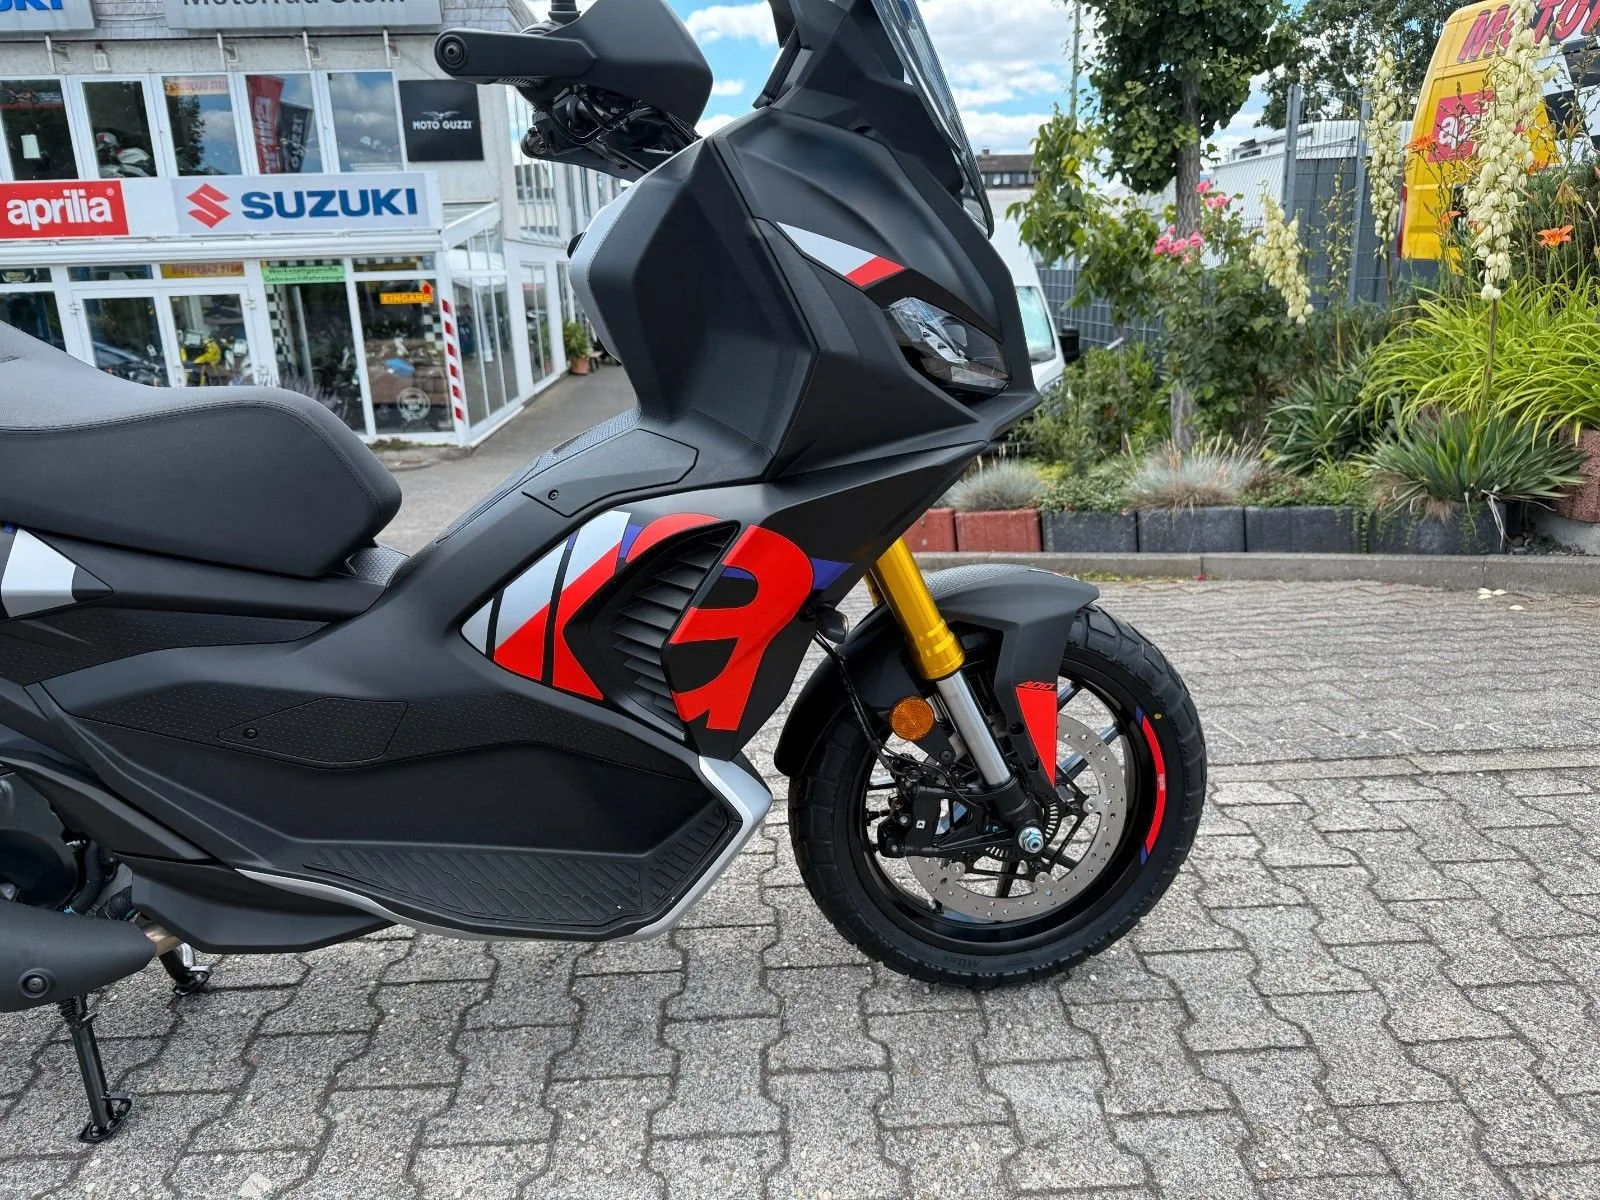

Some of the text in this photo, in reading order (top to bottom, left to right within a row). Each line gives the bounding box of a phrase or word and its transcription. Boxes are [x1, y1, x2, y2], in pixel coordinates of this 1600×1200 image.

[412, 120, 472, 130] MOTO GUZZI
[6, 189, 114, 231] aprilia
[241, 188, 417, 220] SUZUKI
[1017, 681, 1056, 690] 400
